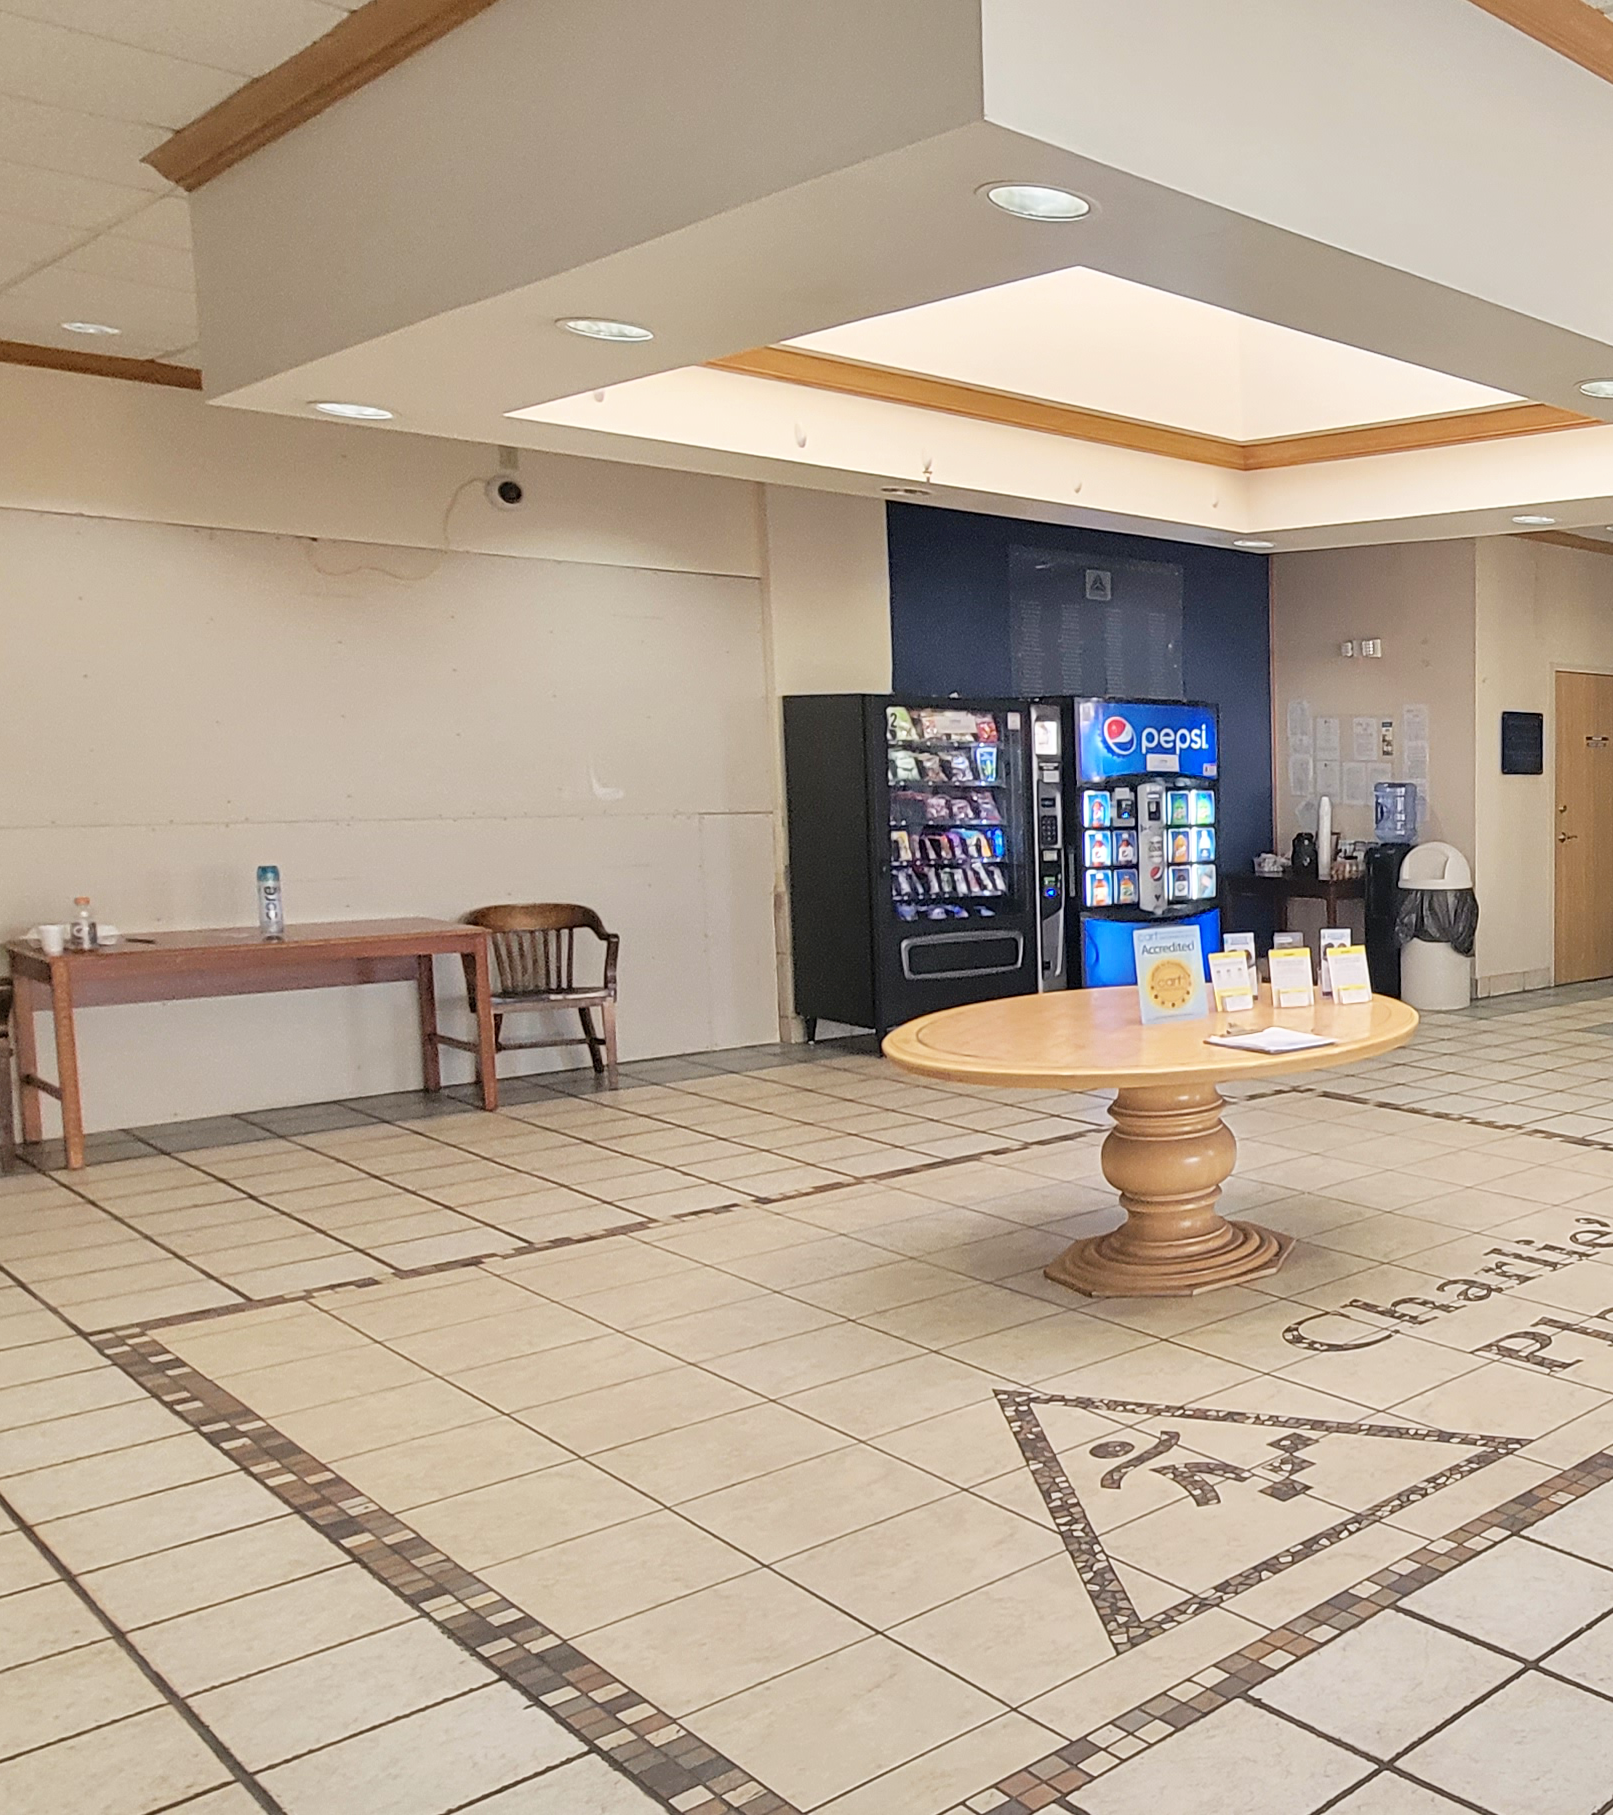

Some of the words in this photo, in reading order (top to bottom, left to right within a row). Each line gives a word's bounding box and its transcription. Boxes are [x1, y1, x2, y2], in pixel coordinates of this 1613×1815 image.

[1142, 723, 1209, 755] pepsi
[263, 885, 278, 920] core
[1141, 940, 1195, 955] Accredited
